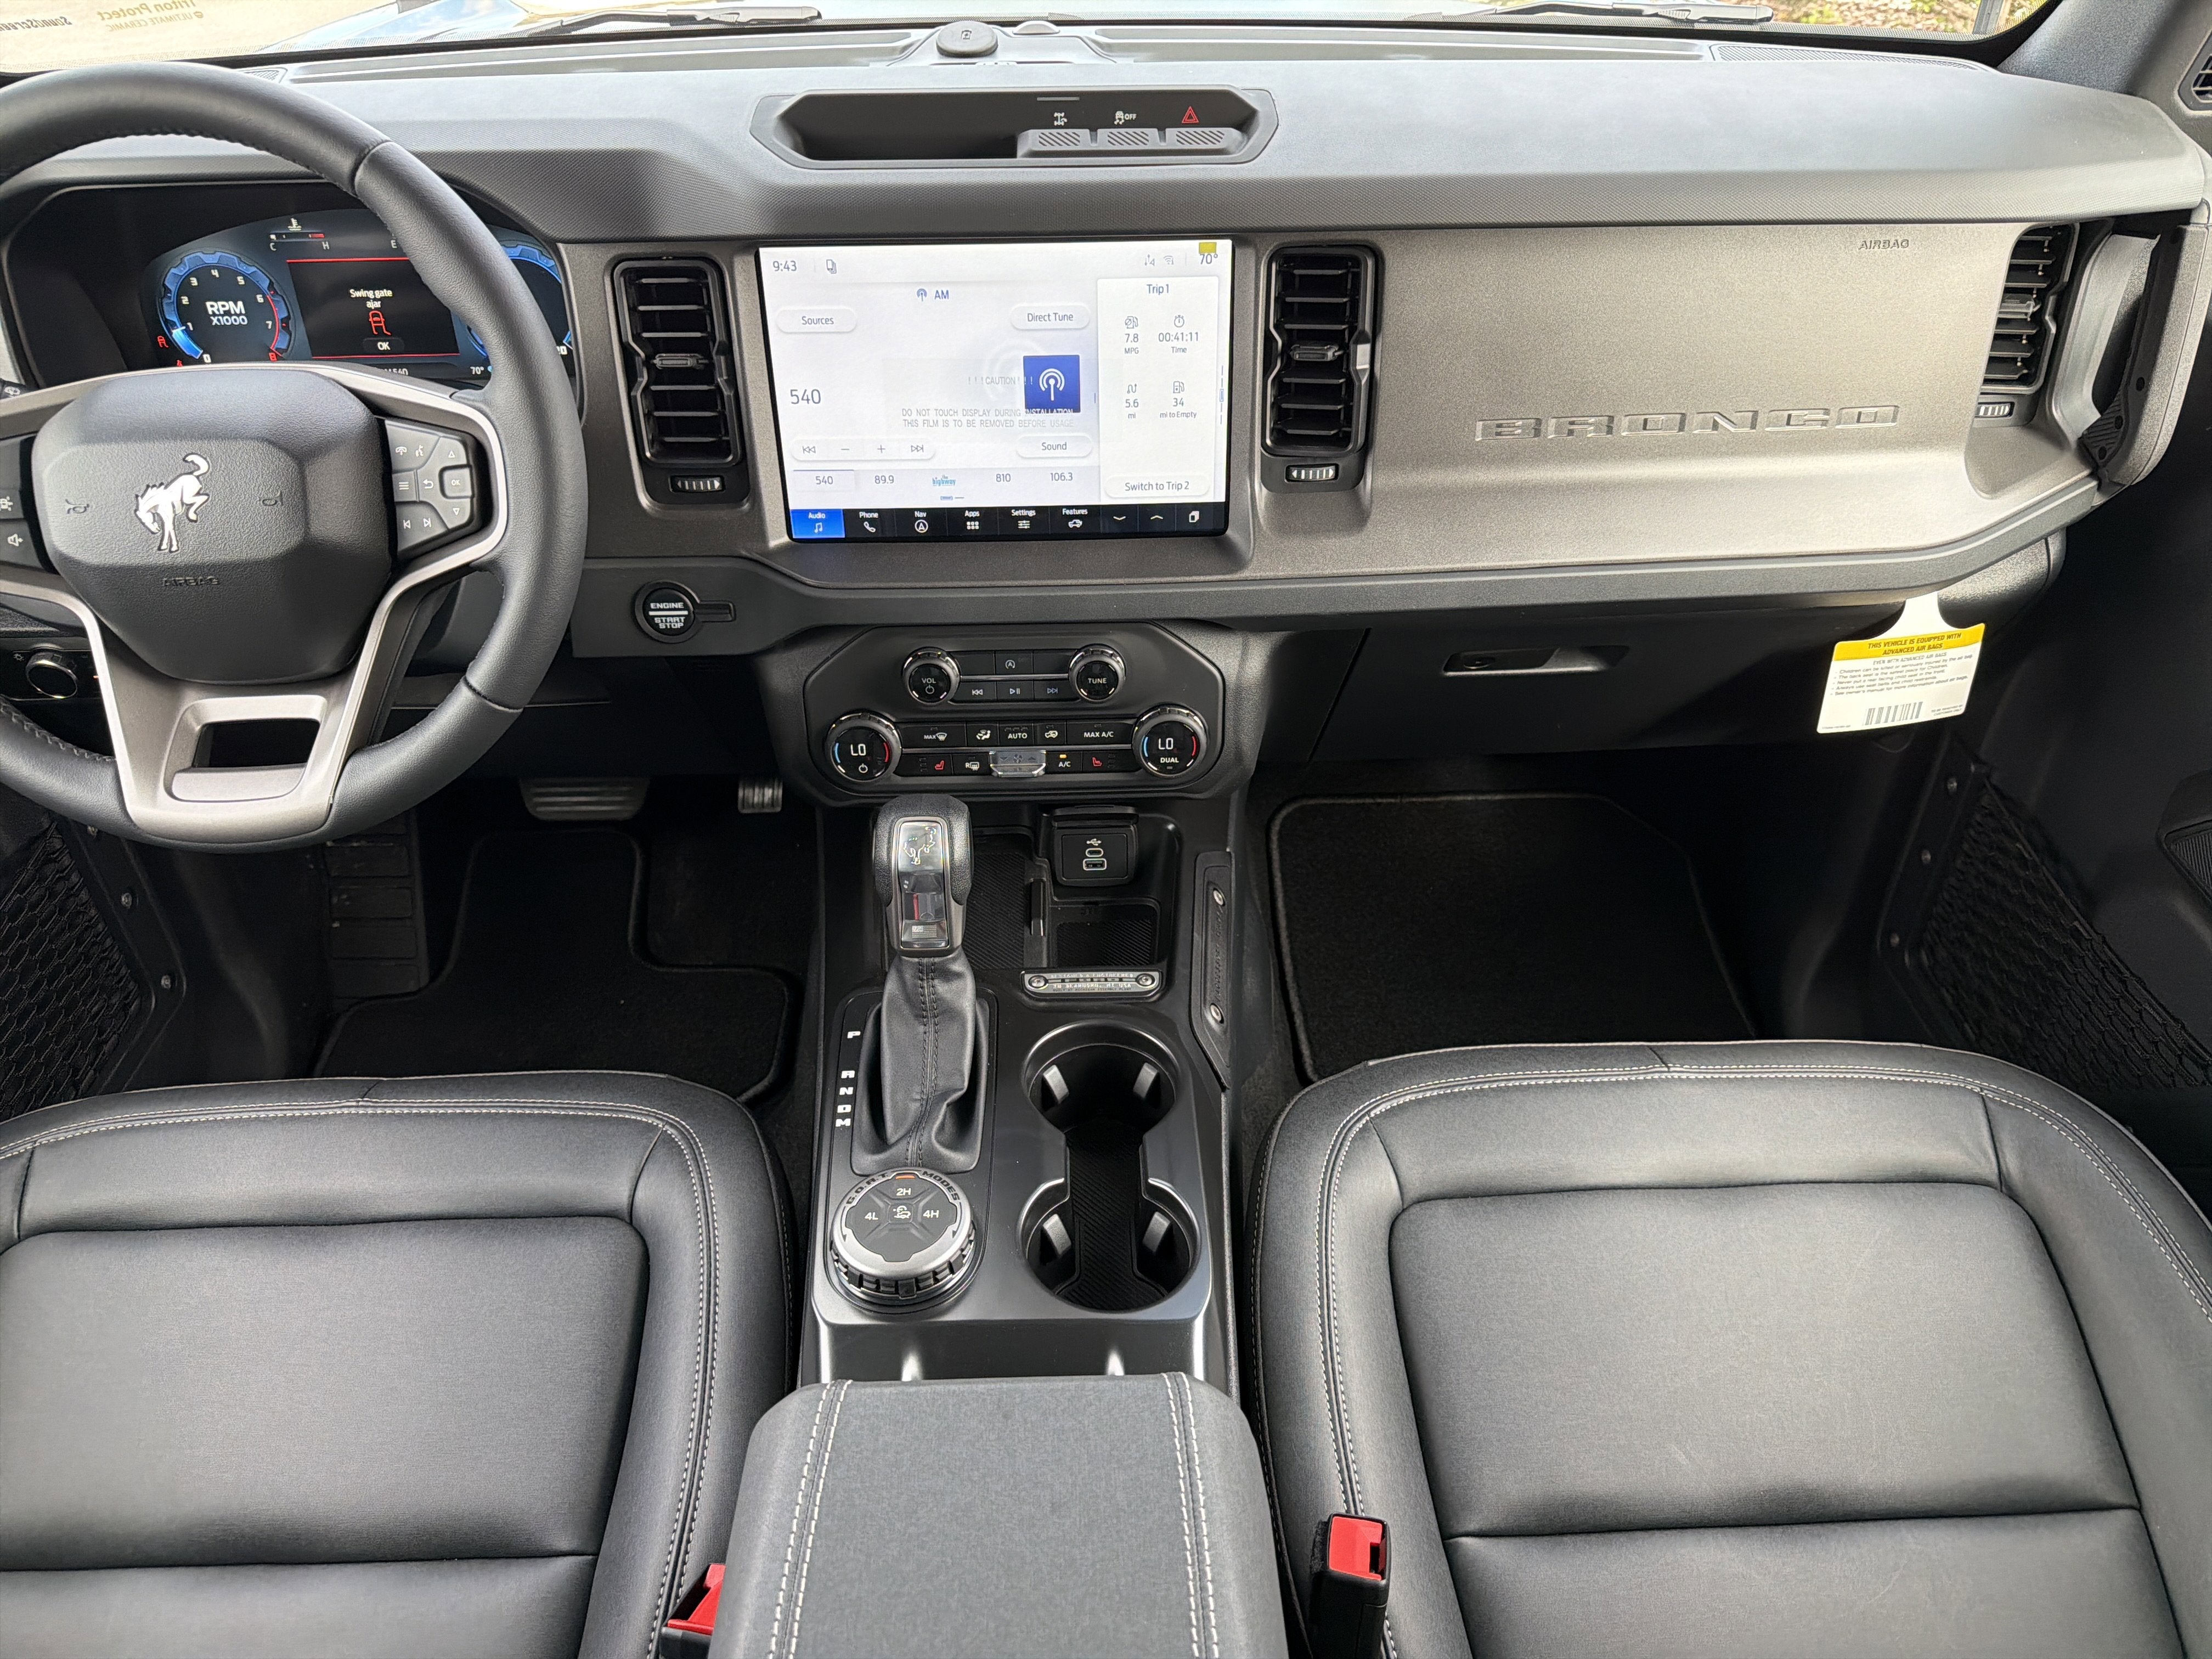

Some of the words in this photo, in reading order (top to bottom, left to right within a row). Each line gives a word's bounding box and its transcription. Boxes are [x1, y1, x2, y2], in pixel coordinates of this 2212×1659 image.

[322, 241, 330, 250] H
[391, 240, 397, 249] E
[1858, 239, 1909, 250] AIRBAG
[1199, 253, 1218, 265] 70°
[772, 260, 798, 272] 9:43
[211, 269, 219, 278] 4
[190, 277, 198, 286] 3
[237, 276, 245, 285] 5
[349, 289, 374, 298] Swing
[375, 289, 393, 298] gate
[1146, 284, 1164, 295] Trip
[1166, 284, 1170, 294] 1
[256, 295, 264, 303] 6
[934, 290, 949, 300] AM
[180, 296, 189, 304] 2
[366, 300, 381, 309] ajar
[206, 301, 246, 314] RPM
[210, 315, 247, 325] X1000
[802, 315, 834, 325] Sources
[1027, 313, 1051, 322] Direct
[1053, 312, 1074, 321] Tune
[266, 321, 272, 329] 7
[1125, 333, 1139, 343] 7.8
[1158, 332, 1199, 342] 00:41:11
[377, 342, 391, 351] OK
[203, 354, 211, 363] 0
[269, 353, 277, 361] 8
[470, 366, 484, 375] 70°
[985, 376, 1015, 385] CAUTION
[790, 389, 821, 405] 540
[1125, 399, 1139, 408] 5.6
[1173, 398, 1184, 407] 34
[902, 408, 912, 416] DO
[915, 408, 930, 416] NOT
[934, 408, 958, 416] TOUCH
[962, 408, 990, 416] DISPLAY
[995, 408, 1021, 416] DURING
[903, 419, 918, 427] THIS
[922, 419, 939, 427] FILM
[943, 419, 949, 427] IS
[953, 419, 963, 427] TO
[967, 419, 976, 427] BE
[980, 419, 1014, 427] REMOVED
[1018, 419, 1046, 427] BEFORE
[1050, 419, 1074, 427] USAGE
[1475, 405, 1900, 441] BRONCO
[1041, 442, 1067, 450] Sound
[815, 476, 833, 485] 540
[874, 475, 894, 484] 89.9
[996, 474, 1011, 483] 810
[1051, 472, 1073, 482] 106.3
[932, 477, 956, 487] highway
[1125, 482, 1153, 492] Switch
[1155, 482, 1164, 490] to
[1166, 482, 1183, 492] Trip
[1184, 481, 1189, 490] 2
[1062, 508, 1088, 516] Features
[1916, 635, 1945, 644] EQUIPPED
[1882, 647, 1915, 655] ADVANCED
[1927, 643, 1943, 651] BAGS
[1158, 738, 1173, 750] LO
[850, 743, 866, 756] LO
[839, 1087, 854, 1095] N
[837, 1104, 851, 1113] D
[836, 1119, 851, 1127] M
[922, 1171, 961, 1201] MODES
[896, 1188, 911, 1196] 2H
[865, 1212, 879, 1220] 4L
[923, 1210, 939, 1218] 4H
